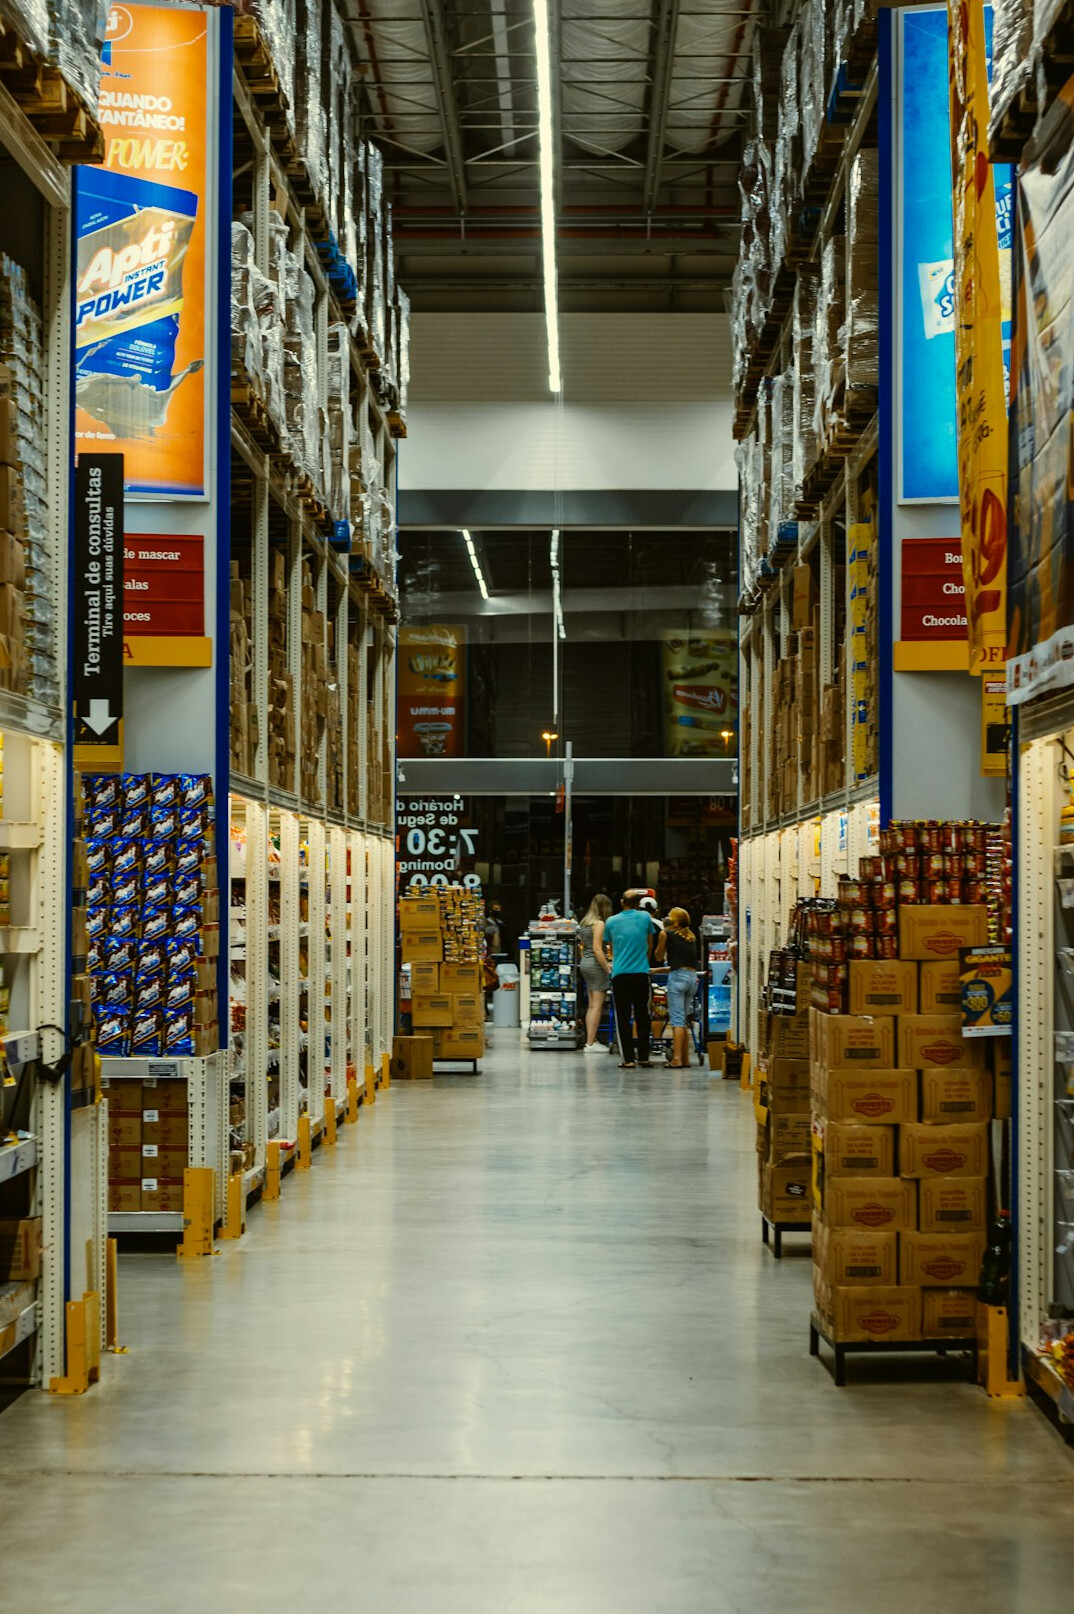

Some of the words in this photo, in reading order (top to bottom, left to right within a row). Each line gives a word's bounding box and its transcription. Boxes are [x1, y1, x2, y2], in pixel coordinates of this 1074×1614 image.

[98, 90, 172, 112] QUANDO
[79, 221, 175, 293] Apti
[124, 260, 166, 283] INSTANT
[76, 271, 165, 326] POWER
[85, 467, 102, 556] consultas
[103, 506, 114, 553] dúvidas
[104, 555, 114, 581] suas
[138, 550, 181, 561] mascar
[84, 561, 101, 585] de
[123, 579, 149, 591] alas
[102, 584, 116, 610] aqui
[84, 589, 101, 676] Terminal
[102, 612, 114, 638] Tire
[922, 615, 968, 626] Chocola
